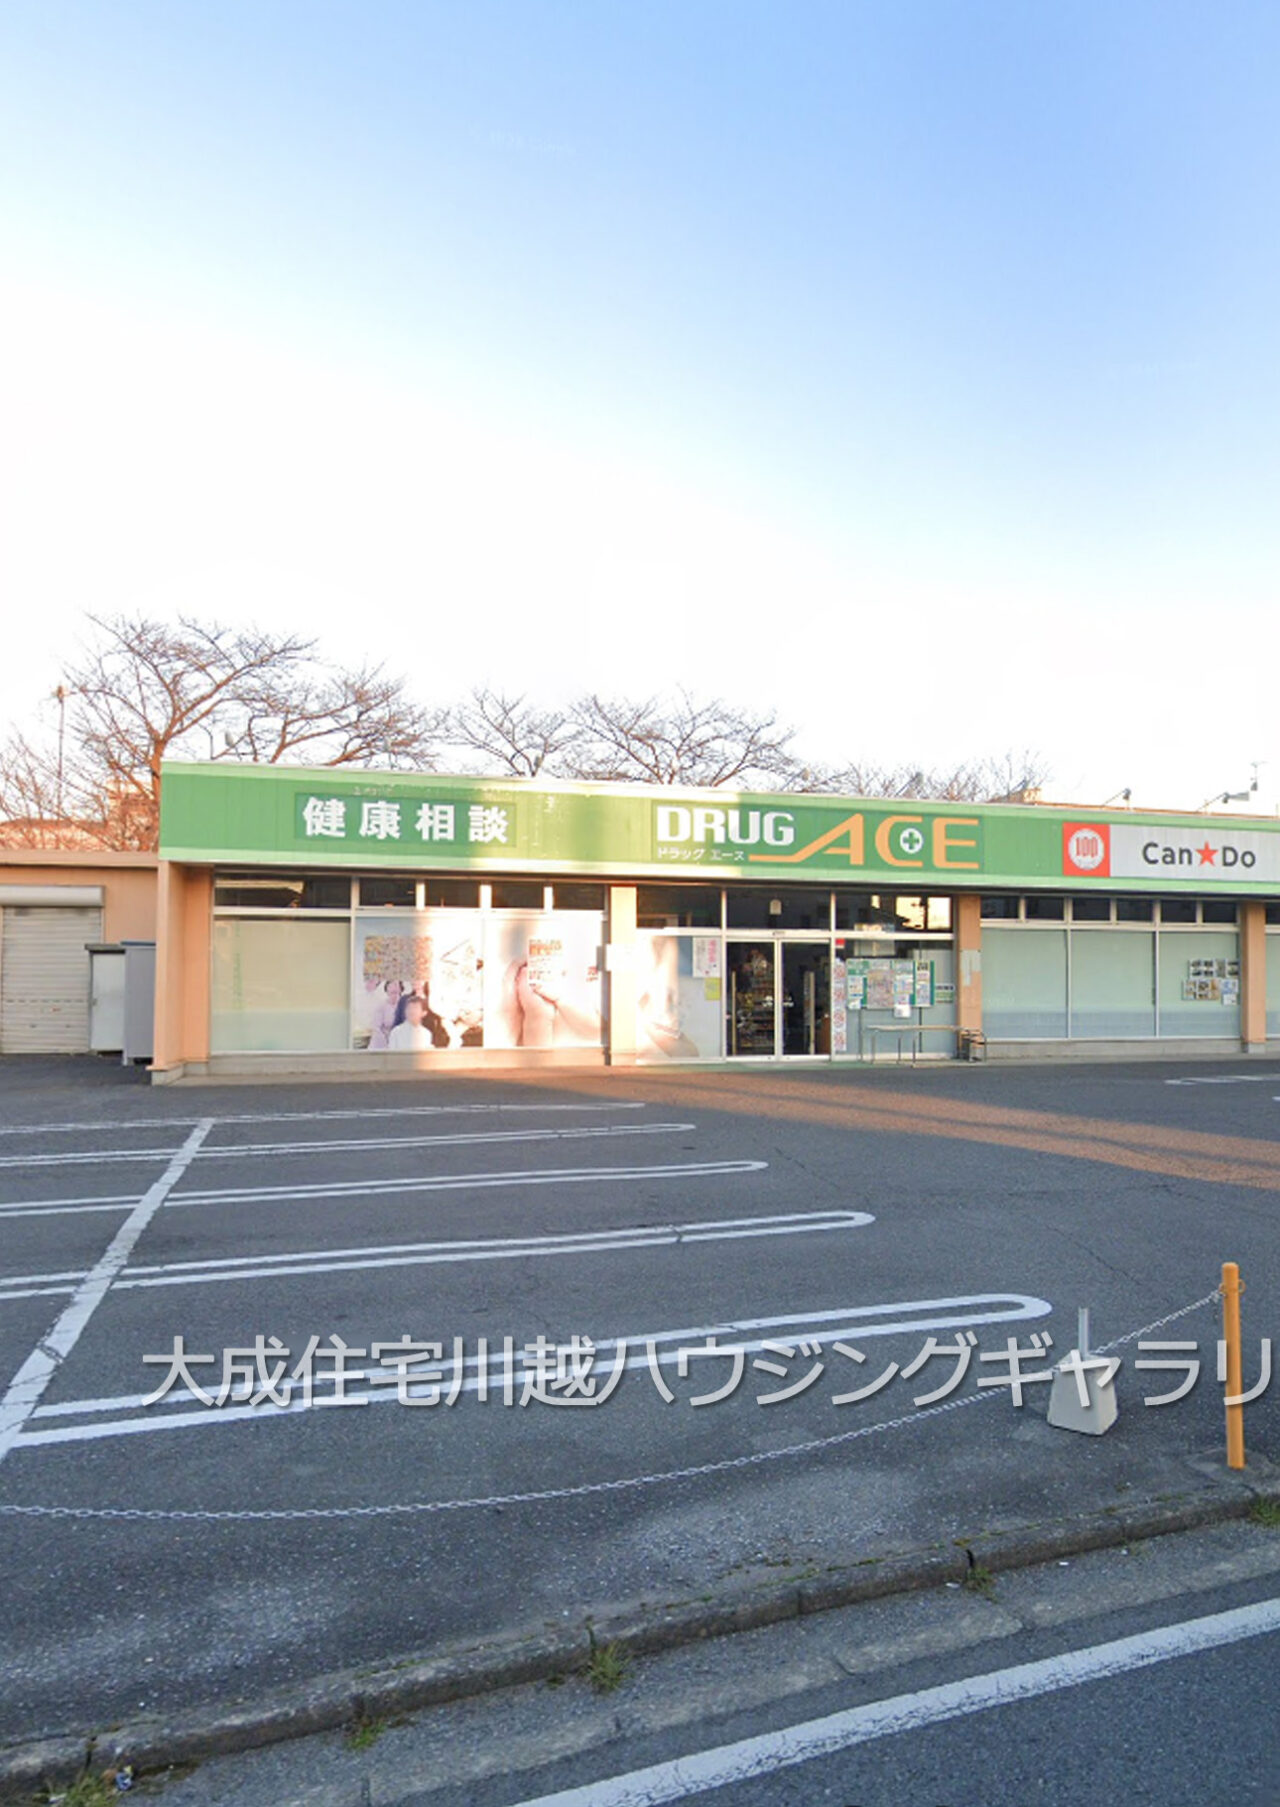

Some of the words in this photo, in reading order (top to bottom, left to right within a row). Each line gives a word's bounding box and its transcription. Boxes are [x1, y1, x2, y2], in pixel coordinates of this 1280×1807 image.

[302, 796, 509, 843] 健康相談
[657, 805, 795, 846] DRUG
[748, 813, 979, 869] ACE
[1076, 836, 1098, 858] 100
